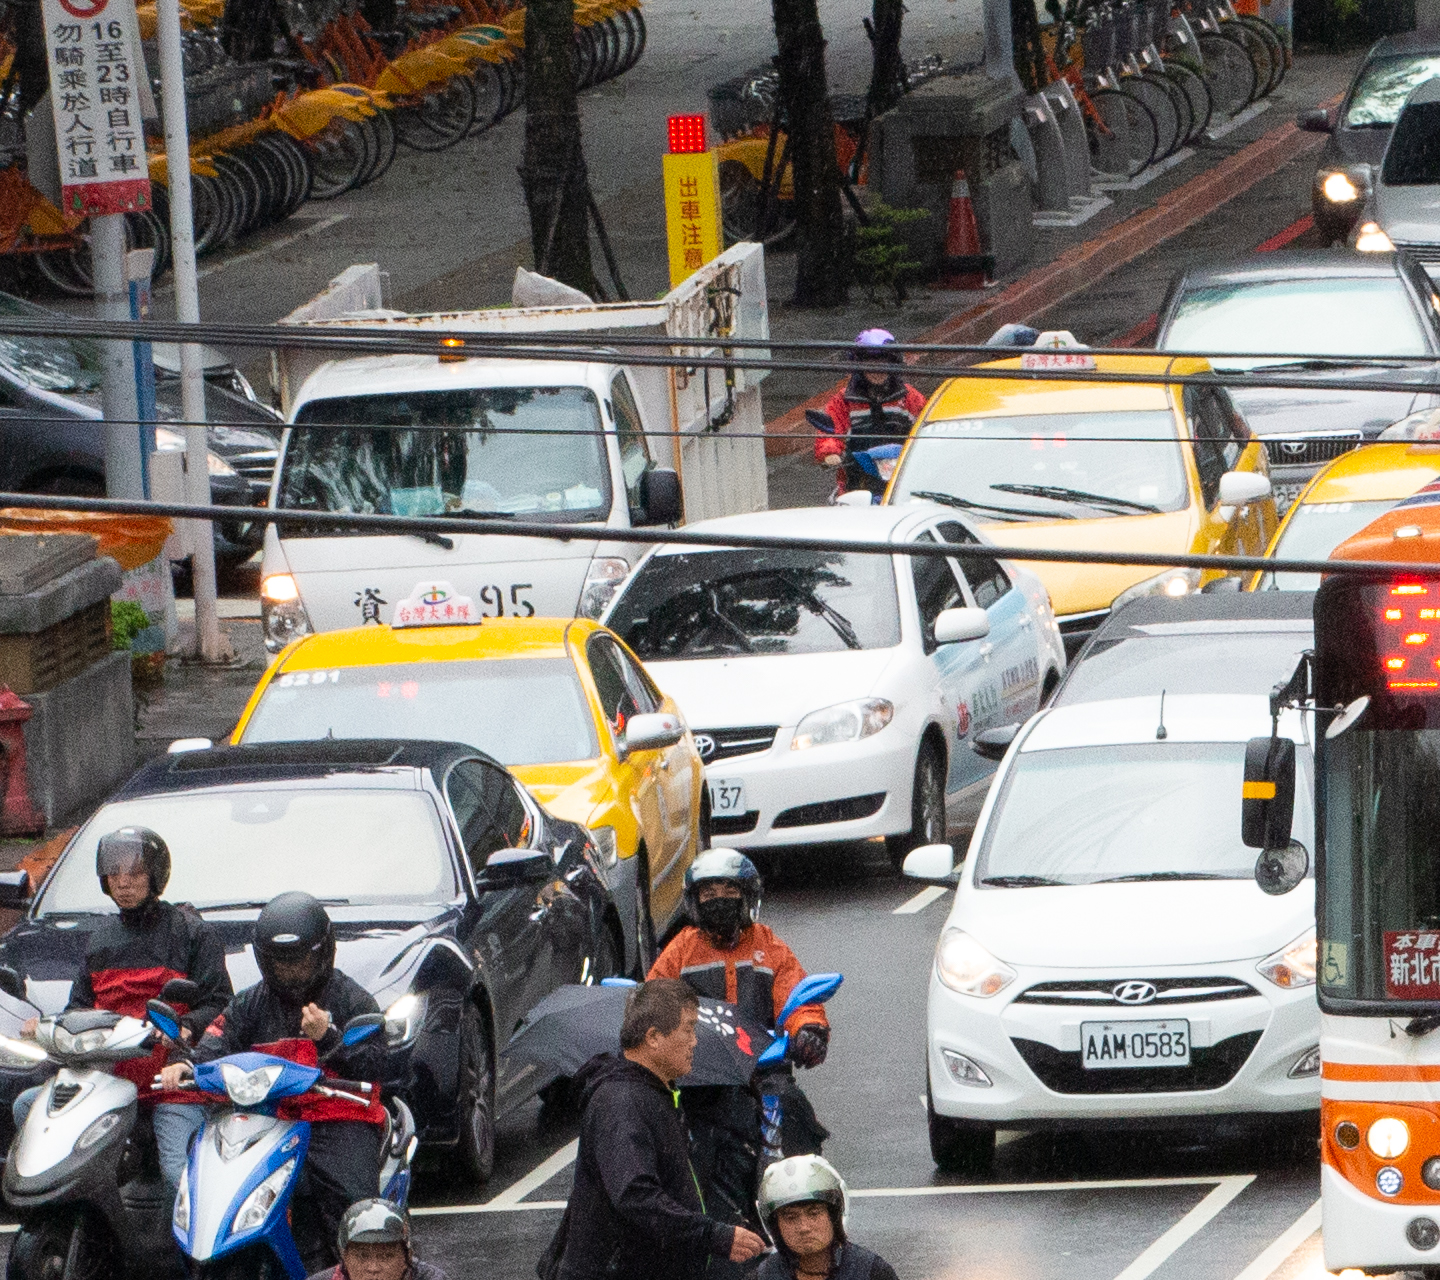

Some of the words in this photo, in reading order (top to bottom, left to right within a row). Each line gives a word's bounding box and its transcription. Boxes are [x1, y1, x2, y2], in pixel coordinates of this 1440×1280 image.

[53, 23, 99, 178] 勿騎乘於人行道
[680, 176, 703, 270] 出車注意
[399, 603, 470, 622] 台灣大車隊
[480, 583, 535, 618] 95
[1086, 1031, 1186, 1060] AAM-0583
